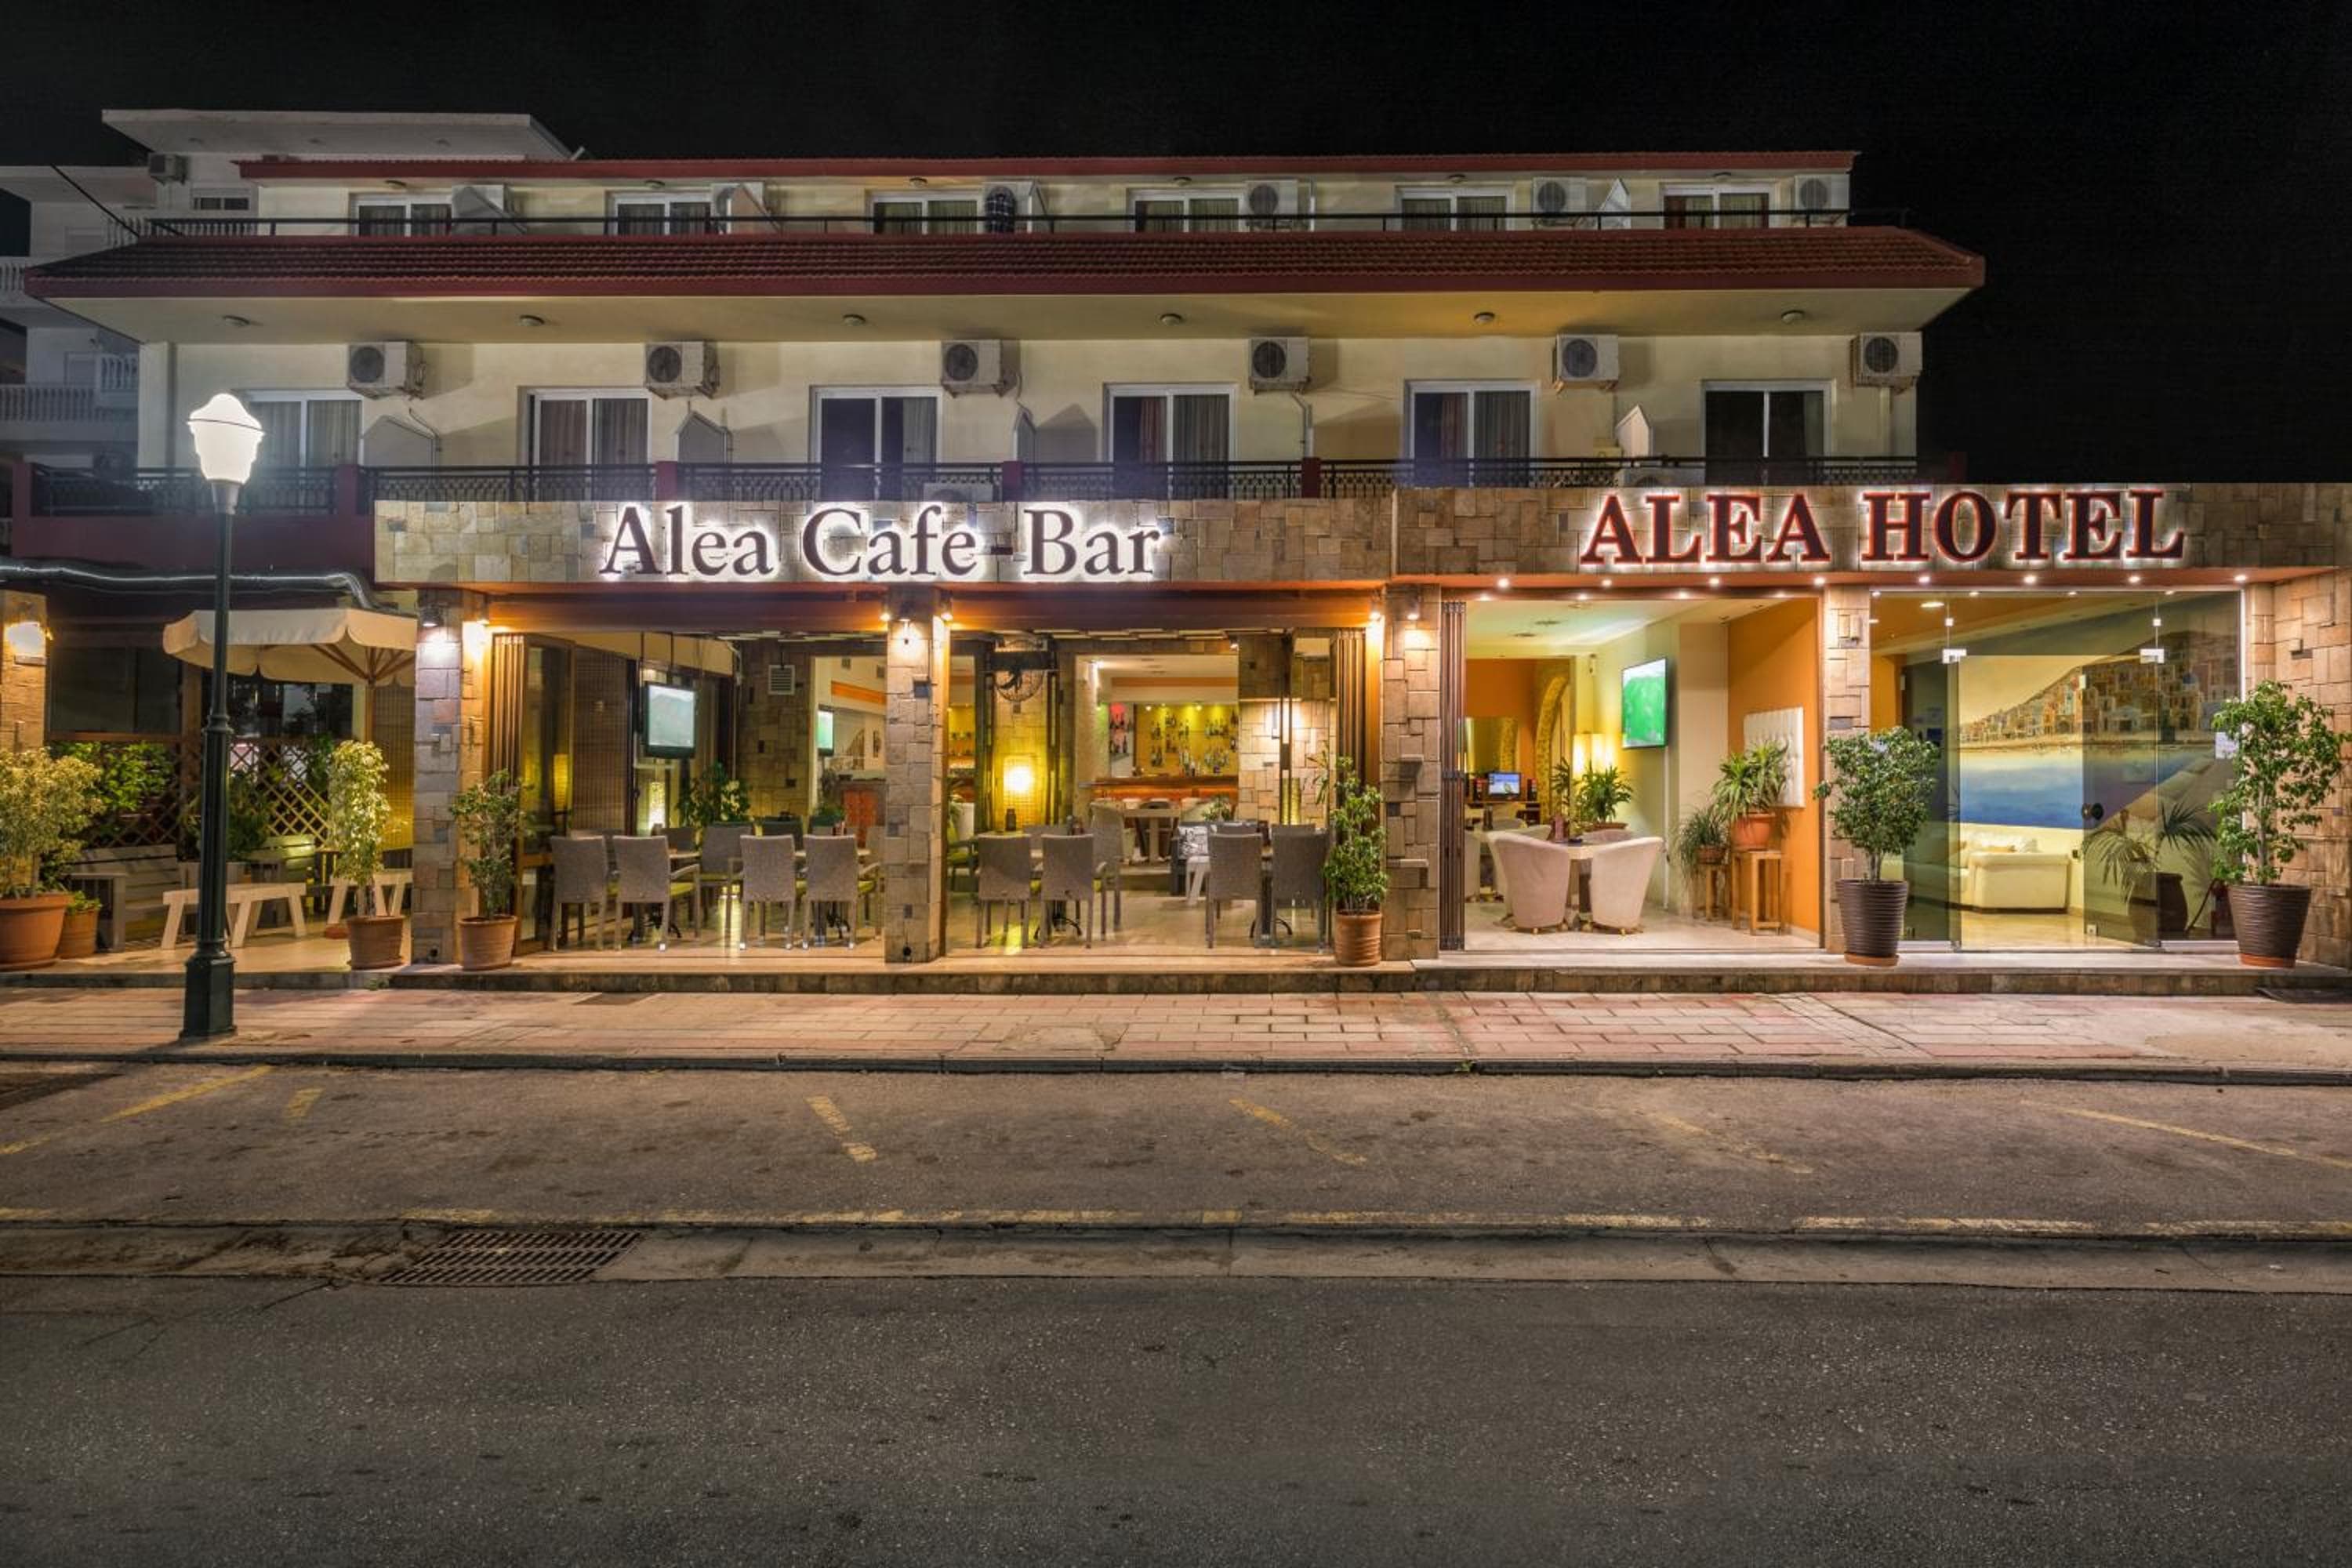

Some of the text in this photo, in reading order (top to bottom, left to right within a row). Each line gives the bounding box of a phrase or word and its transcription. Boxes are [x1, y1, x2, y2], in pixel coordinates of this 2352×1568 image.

[598, 504, 1160, 576] Alea Cafe Bar
[1580, 489, 2184, 564] ALEA HOTEL
